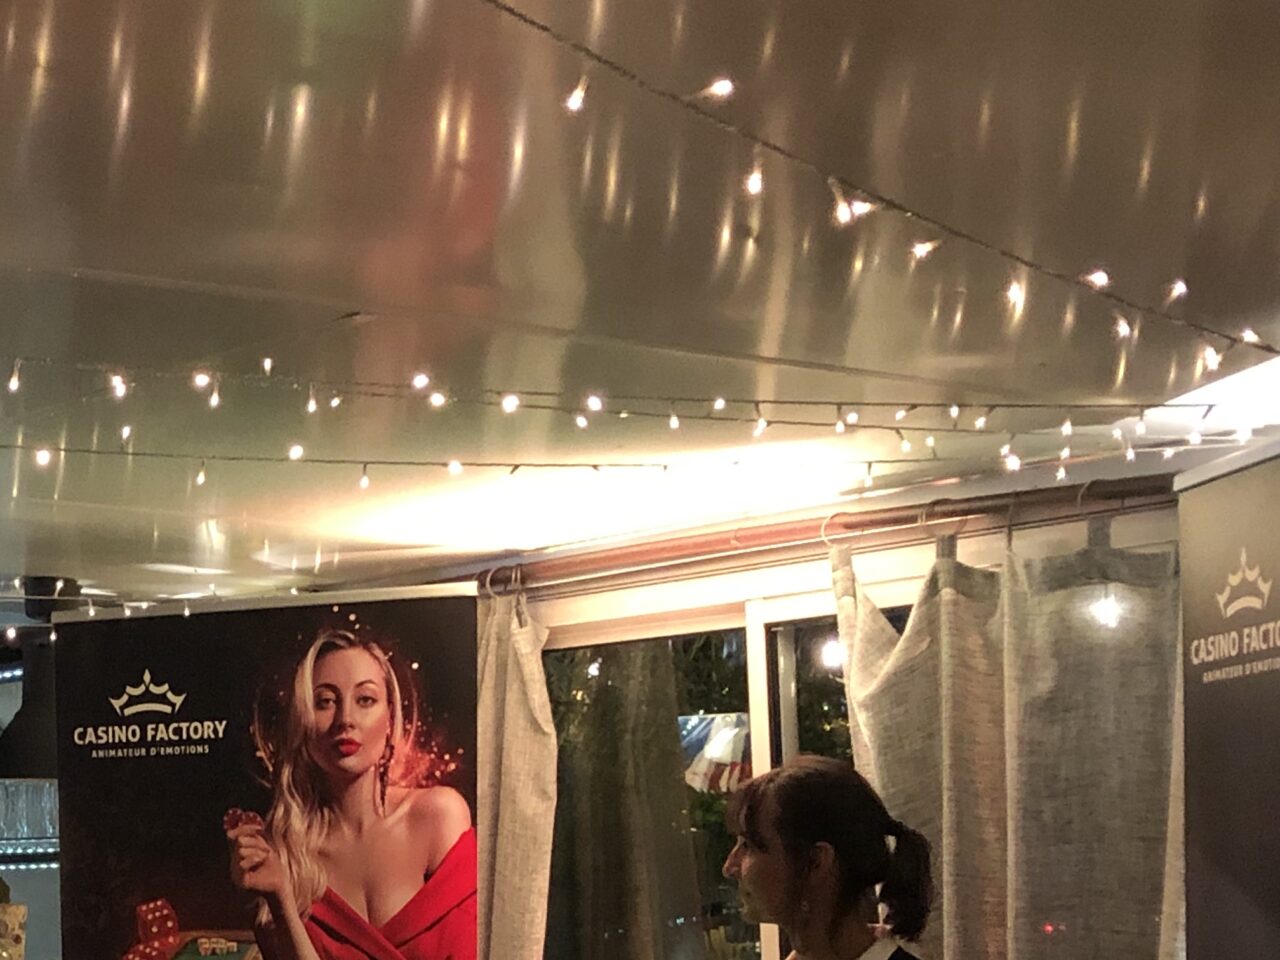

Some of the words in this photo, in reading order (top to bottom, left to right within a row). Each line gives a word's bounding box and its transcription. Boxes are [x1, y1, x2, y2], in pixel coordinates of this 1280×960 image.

[1191, 630, 1239, 665] CASINO
[74, 724, 141, 745] CASINO
[146, 720, 227, 742] FACTORY
[91, 747, 146, 758] ANIMATEUR
[150, 744, 210, 756] D'EMOTIONS
